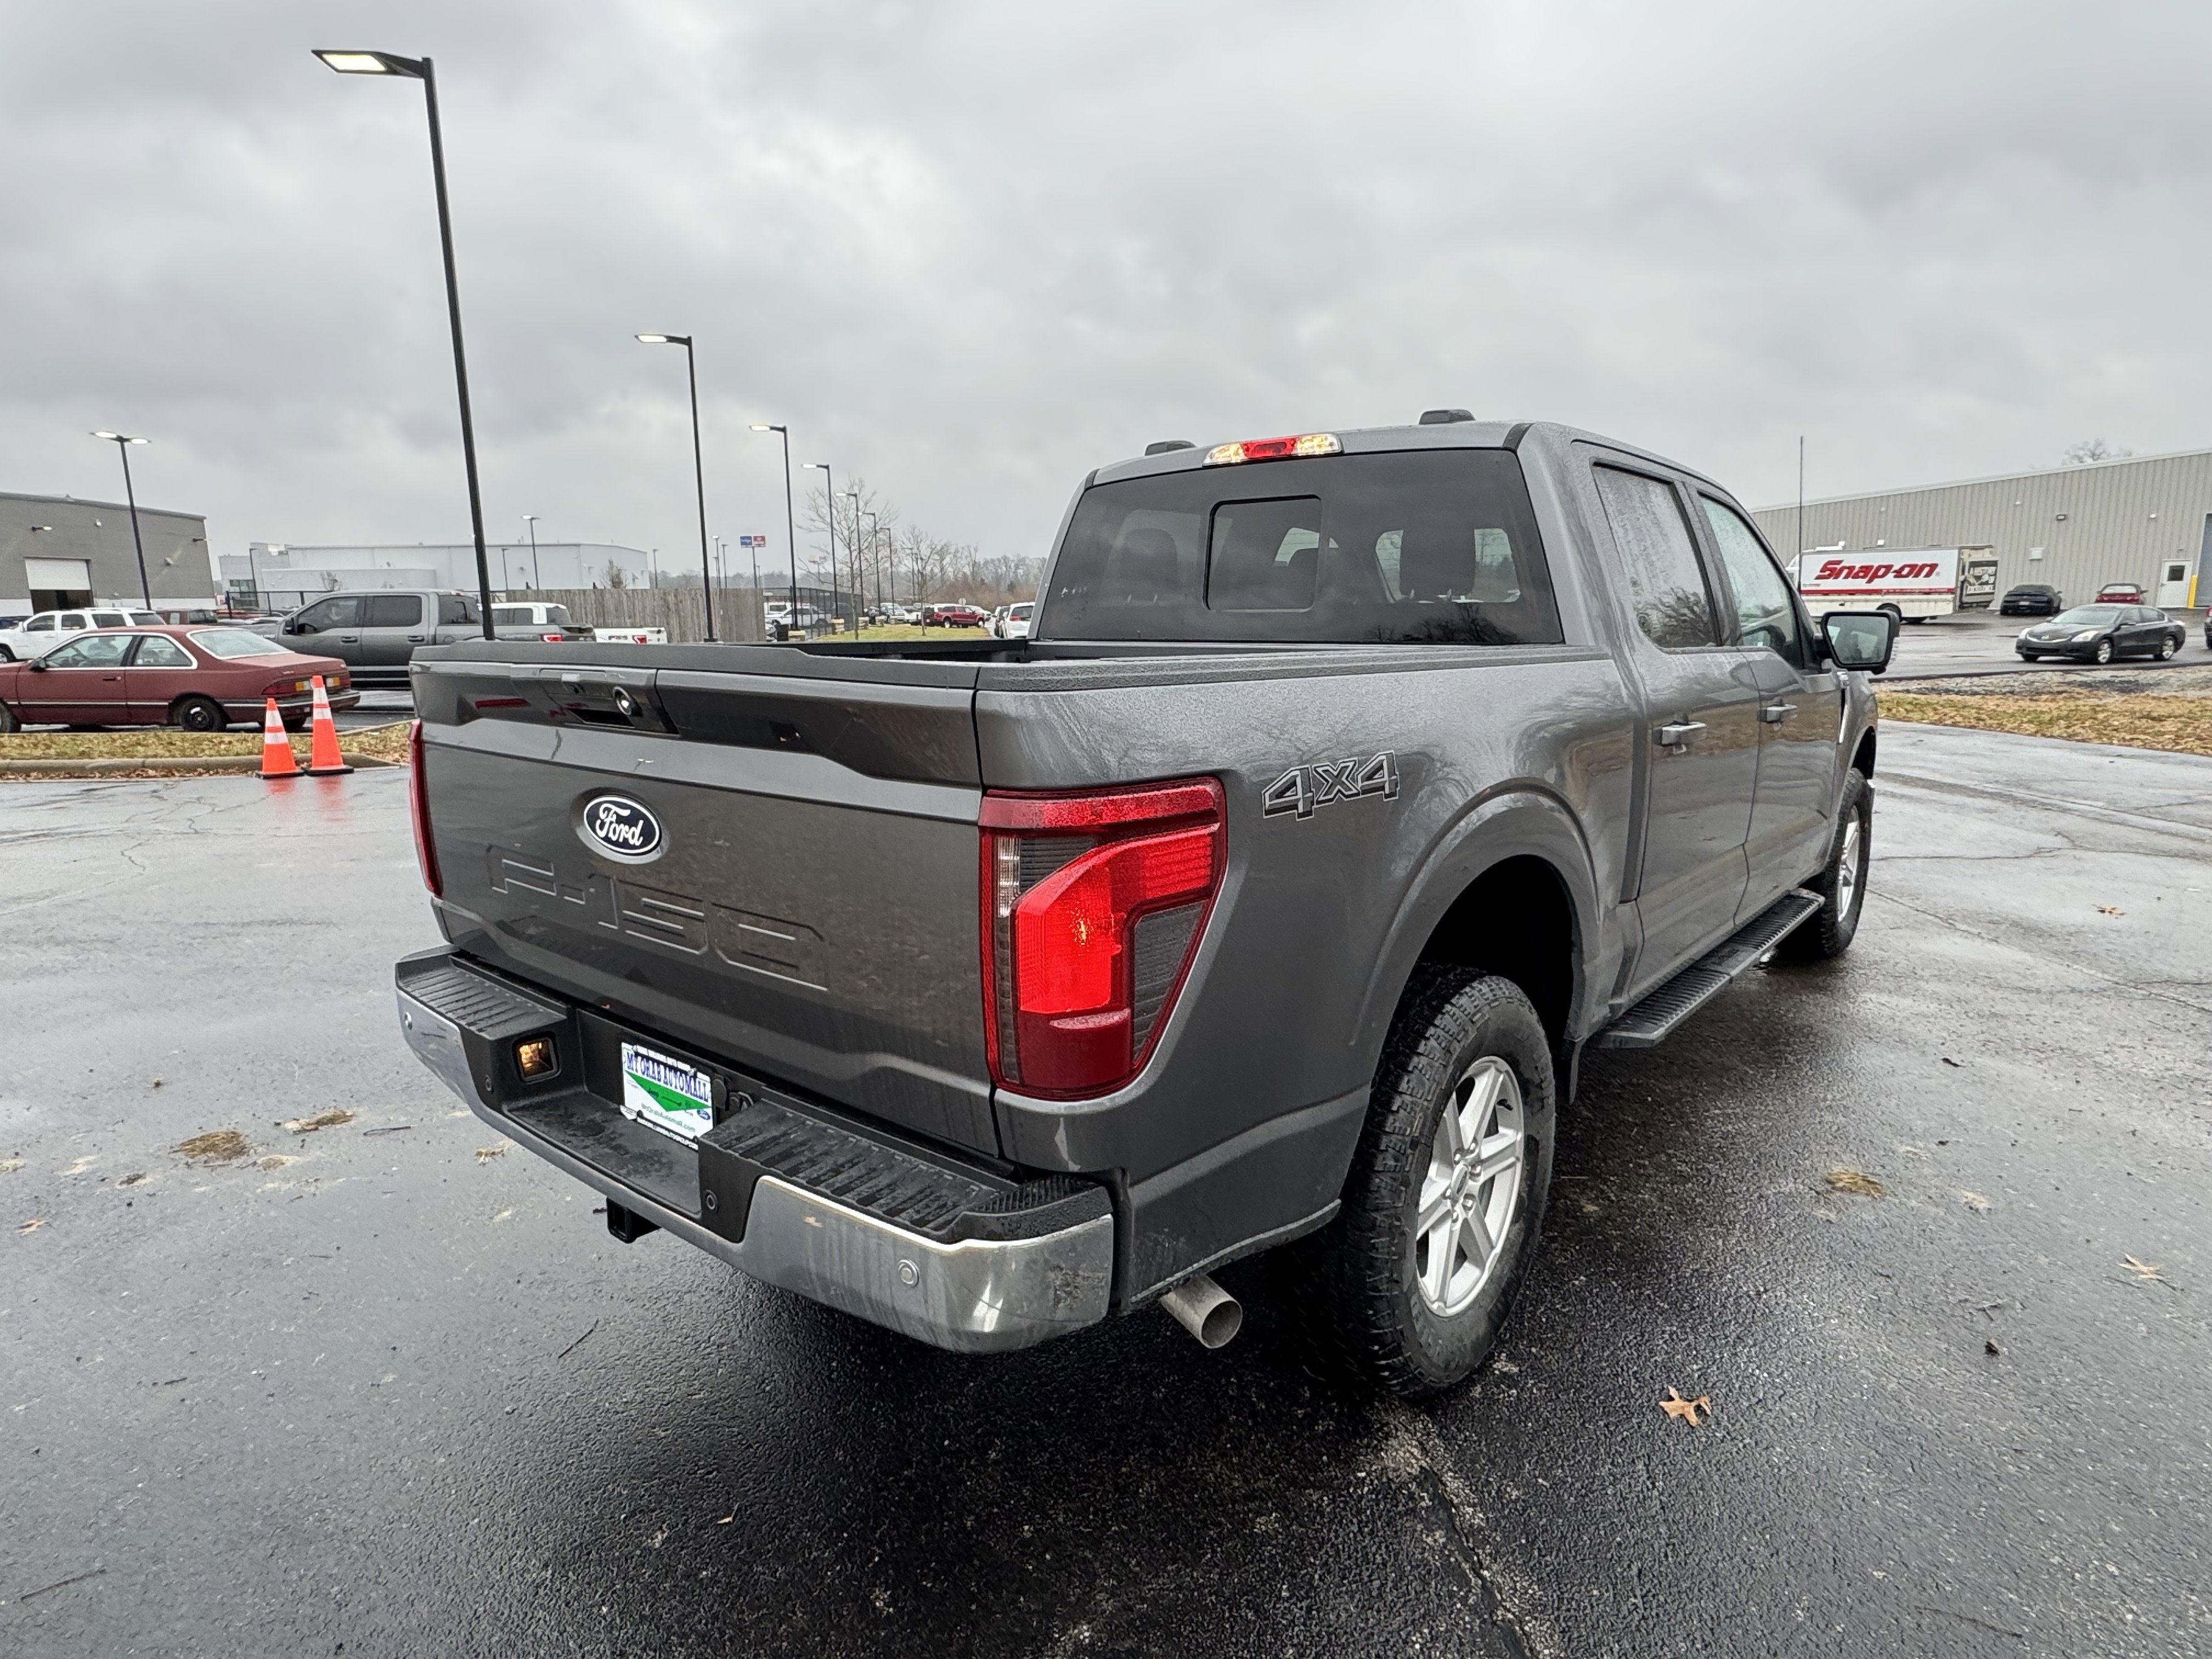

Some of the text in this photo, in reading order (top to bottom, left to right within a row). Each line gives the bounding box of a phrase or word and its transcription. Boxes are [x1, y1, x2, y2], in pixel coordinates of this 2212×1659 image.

[1814, 560, 1939, 584] Snap-on
[596, 803, 644, 846] Ford
[486, 845, 828, 992] F-150
[640, 1058, 662, 1083] ORAB
